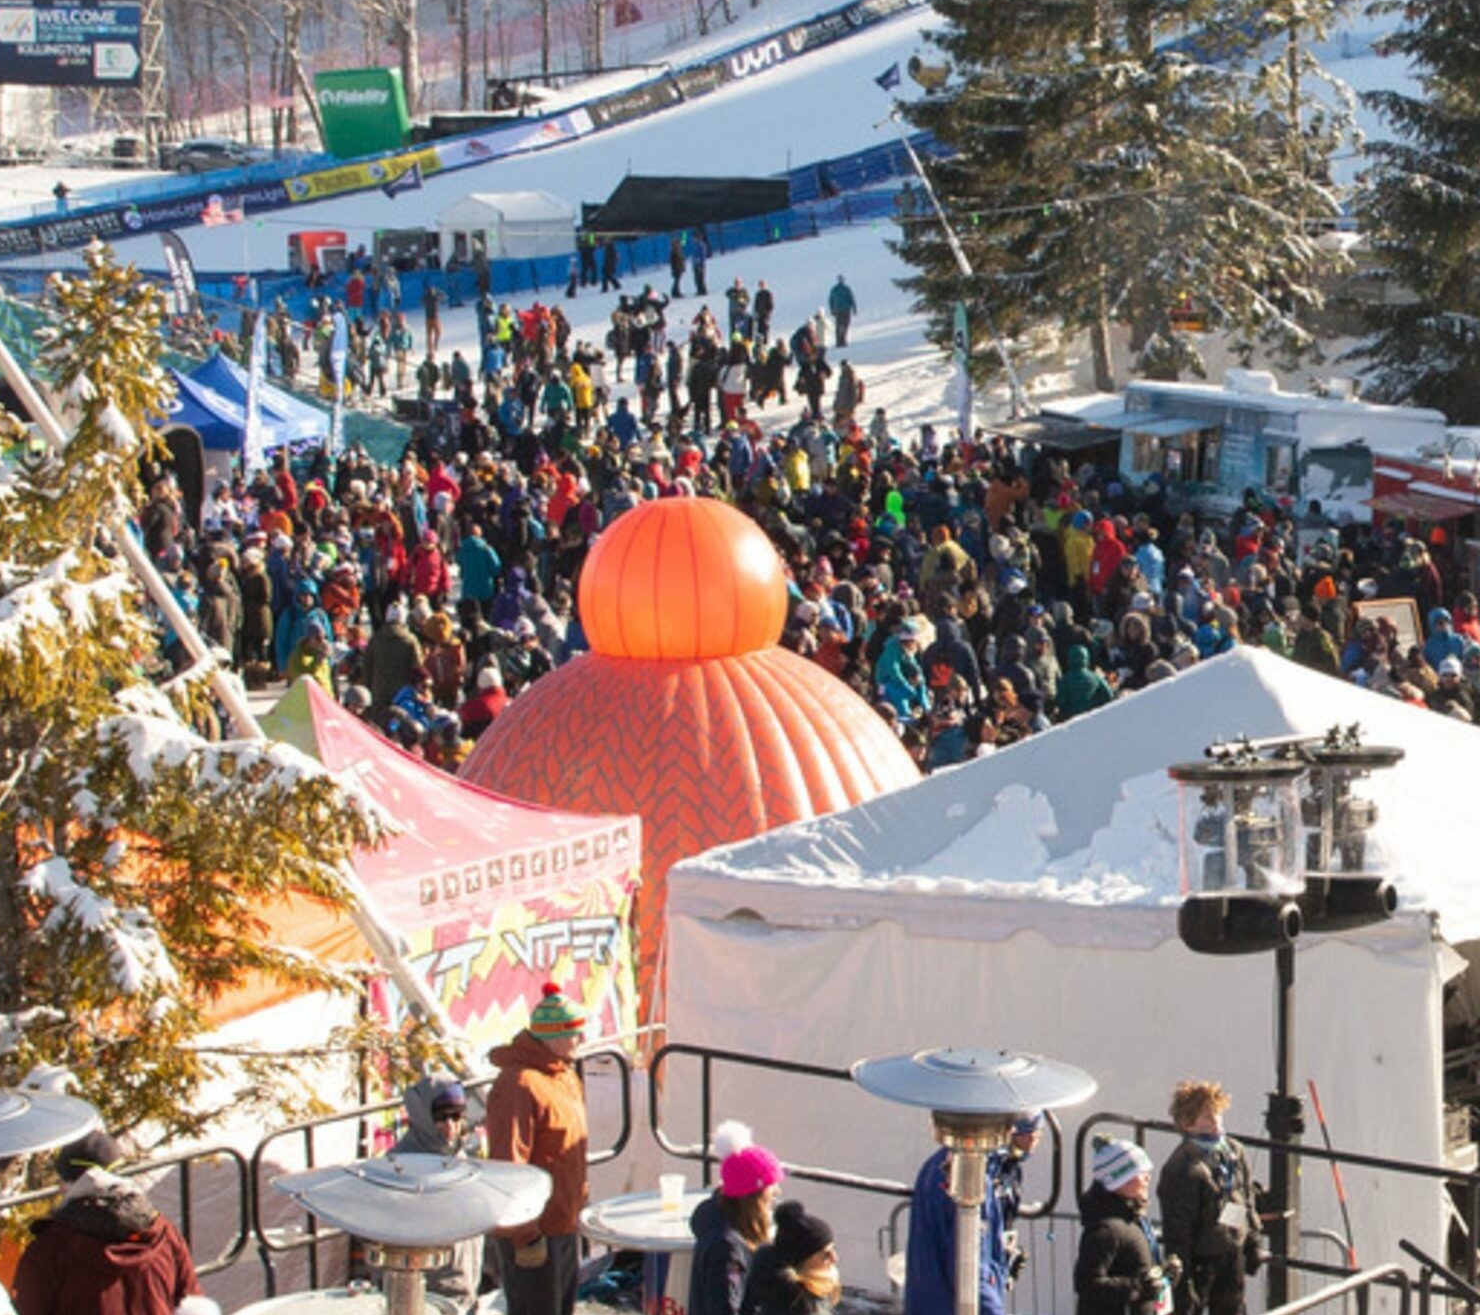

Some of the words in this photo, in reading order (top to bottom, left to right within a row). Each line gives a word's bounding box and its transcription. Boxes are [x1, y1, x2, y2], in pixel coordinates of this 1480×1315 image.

[37, 8, 117, 26] WELCOME
[336, 89, 389, 105] Fidelity
[501, 916, 622, 972] VIPER
